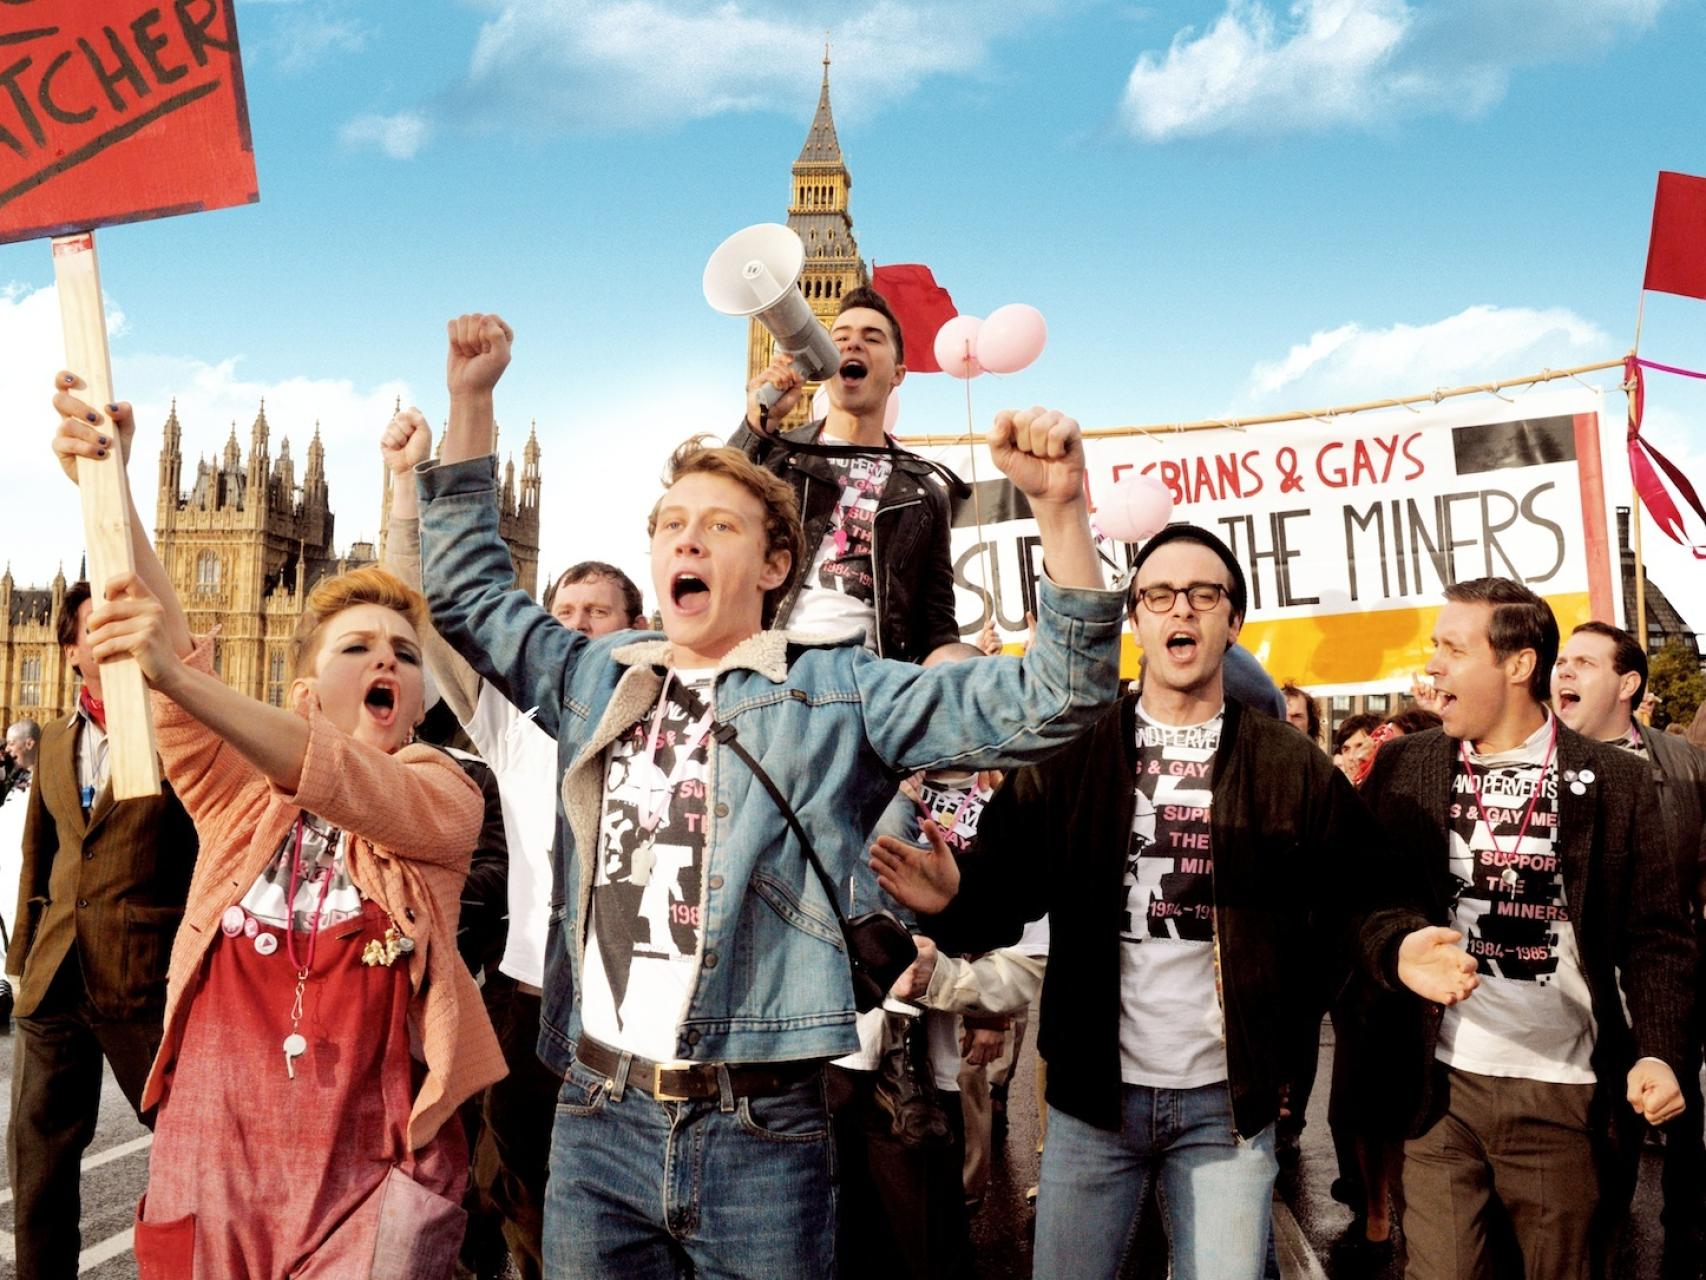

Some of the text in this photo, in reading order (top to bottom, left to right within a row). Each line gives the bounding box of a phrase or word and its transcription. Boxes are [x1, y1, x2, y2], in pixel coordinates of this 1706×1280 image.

[1083, 432, 1425, 513] LBIANS & GAYS
[1218, 508, 1320, 608] THE
[1343, 481, 1566, 601] MINERS
[1148, 760, 1160, 774] &
[1169, 761, 1209, 777] GAY
[1452, 774, 1558, 799] AND PERVERTS
[1466, 806, 1479, 820] &
[1486, 808, 1523, 825] GAY
[1169, 832, 1209, 849] THE
[1480, 851, 1560, 872] SUPPOR
[1150, 902, 1213, 920] 1984-19
[1498, 901, 1569, 920] MINERS
[1469, 939, 1548, 960] 1984-1985
